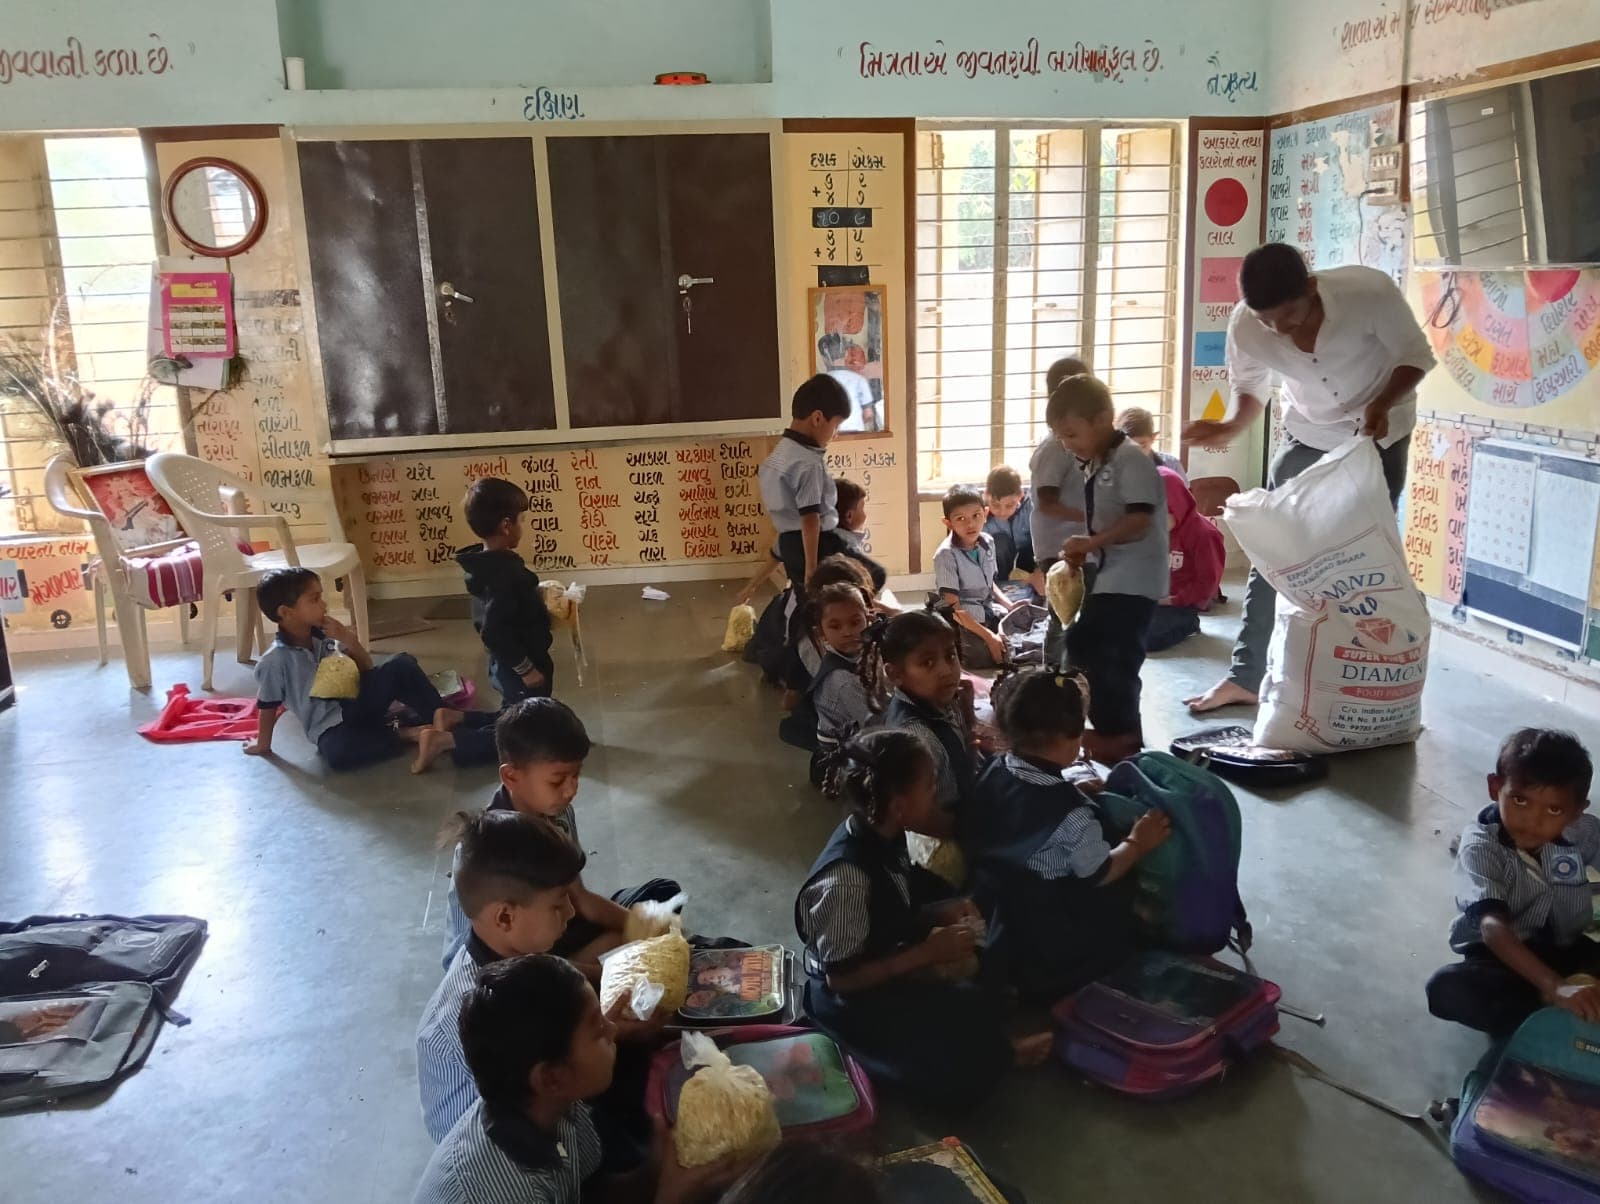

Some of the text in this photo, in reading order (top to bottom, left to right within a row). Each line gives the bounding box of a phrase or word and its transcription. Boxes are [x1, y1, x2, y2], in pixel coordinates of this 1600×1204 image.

[523, 86, 585, 121] દક્ષિણ
[810, 152, 837, 168] દશક
[1207, 231, 1235, 246] લાલ
[520, 456, 559, 473] જંગલ
[570, 448, 598, 471] રેતી
[626, 451, 671, 467] આકાશ
[525, 473, 563, 494] પાણી
[575, 475, 602, 491] દાન
[629, 471, 665, 486] વાદળ
[578, 491, 621, 510] વિશાલ
[530, 516, 563, 532] વાઘ
[59, 542, 90, 555] નામ
[582, 531, 620, 552] વાંદરો
